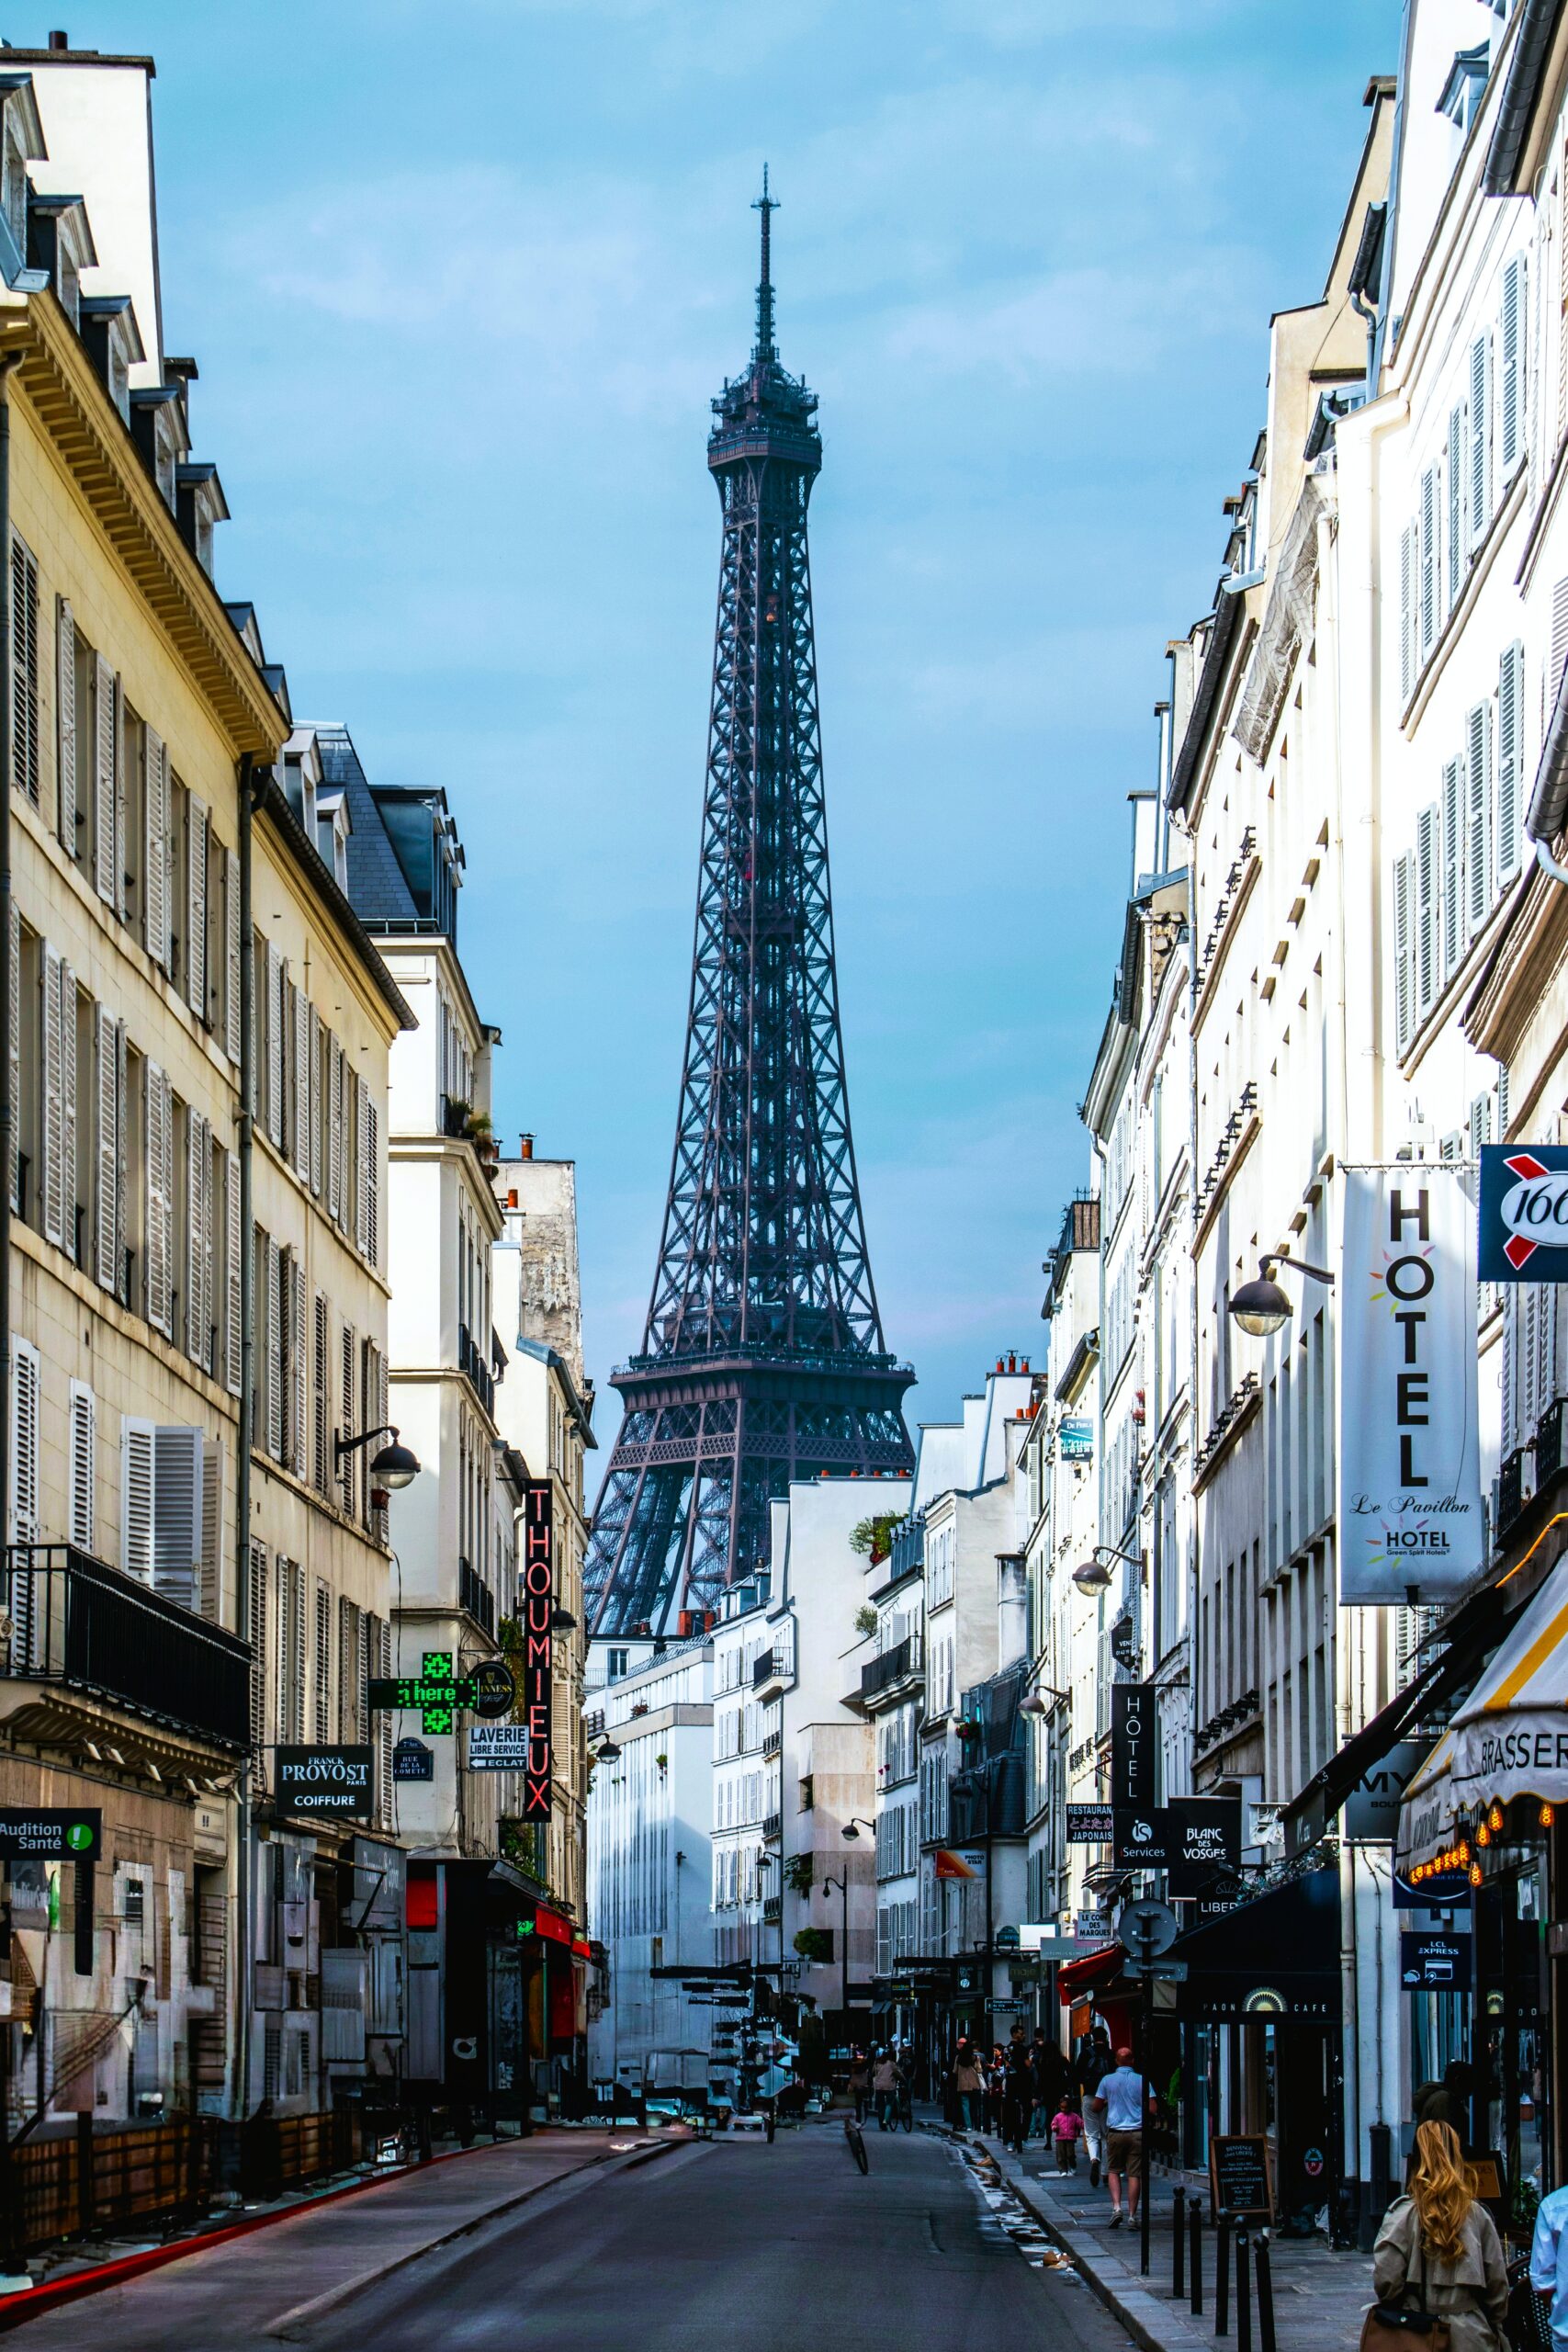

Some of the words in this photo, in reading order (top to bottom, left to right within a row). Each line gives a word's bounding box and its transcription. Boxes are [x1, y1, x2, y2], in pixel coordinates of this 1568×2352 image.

[1385, 1189, 1435, 1487] HOTEL
[1348, 1493, 1382, 1515] Le
[1388, 1495, 1472, 1514] Pavillon
[1386, 1532, 1450, 1547] HOTEL
[527, 1488, 551, 1813] THOUMIEUX
[414, 1685, 457, 1701] here
[480, 1684, 513, 1693] INNESS
[470, 1728, 526, 1743] LAVERIE
[469, 1744, 492, 1755] LIBRE
[493, 1744, 525, 1755] SERVICE
[1125, 1696, 1141, 1798] HÔTEL
[309, 1757, 344, 1765] FRANCK
[281, 1764, 368, 1781] PROVOST
[294, 1795, 355, 1806] COIFFURE
[1068, 1806, 1111, 1815] RESTAURAN
[0, 1823, 62, 1836] Audition
[1072, 1831, 1112, 1840] JAPONAIS
[1186, 1827, 1223, 1842] BLANC
[18, 1837, 62, 1849] Santé
[1182, 1848, 1227, 1860] VOSGES
[1079, 1928, 1111, 1937] MARQUES
[1202, 2003, 1235, 2011] PAON
[1293, 2004, 1326, 2012] CAFE
